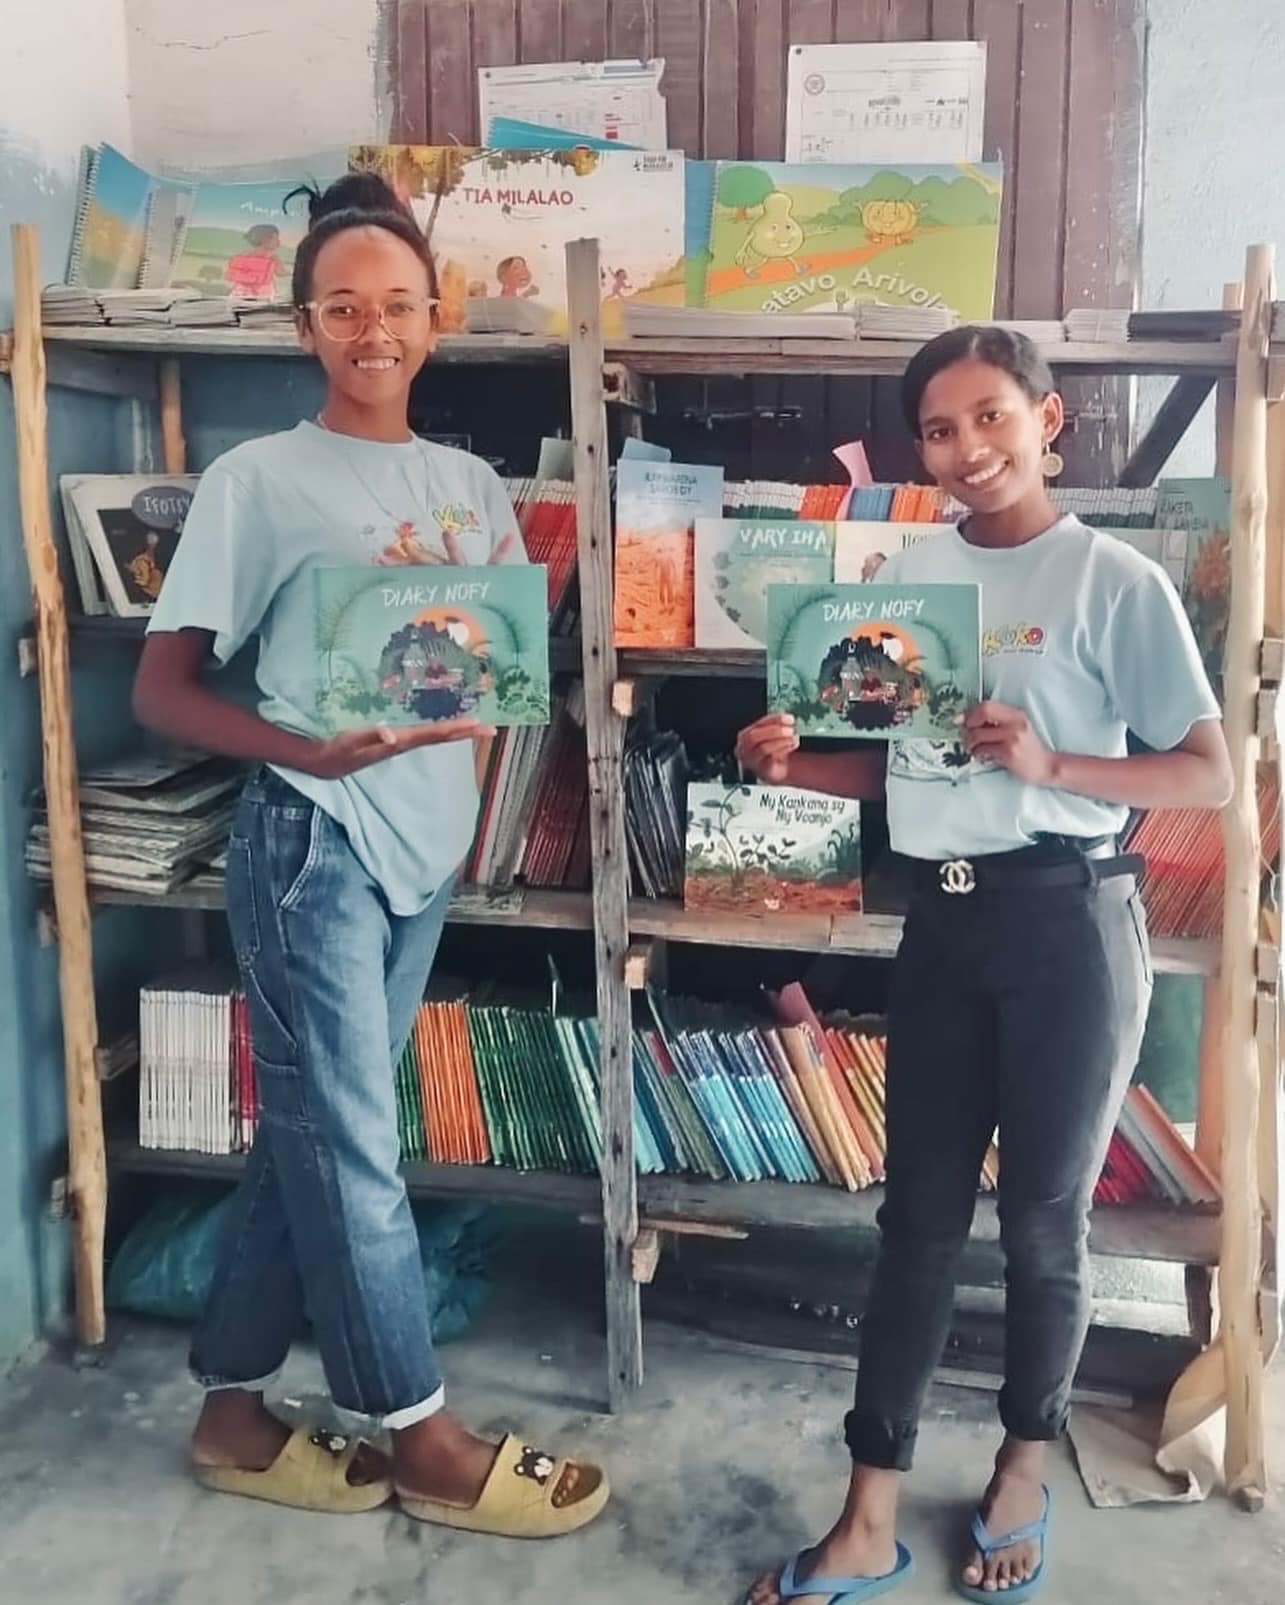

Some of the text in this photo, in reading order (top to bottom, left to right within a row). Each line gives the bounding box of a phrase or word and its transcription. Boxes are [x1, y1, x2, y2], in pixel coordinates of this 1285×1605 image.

[463, 187, 575, 206] TIA MILALAO
[761, 274, 836, 313] atavo
[740, 527, 787, 550] VARY
[381, 581, 491, 608] DIARY NOFY
[822, 597, 925, 622] DIARY NOFY
[760, 793, 776, 811] Ny
[776, 808, 793, 825] Ny
